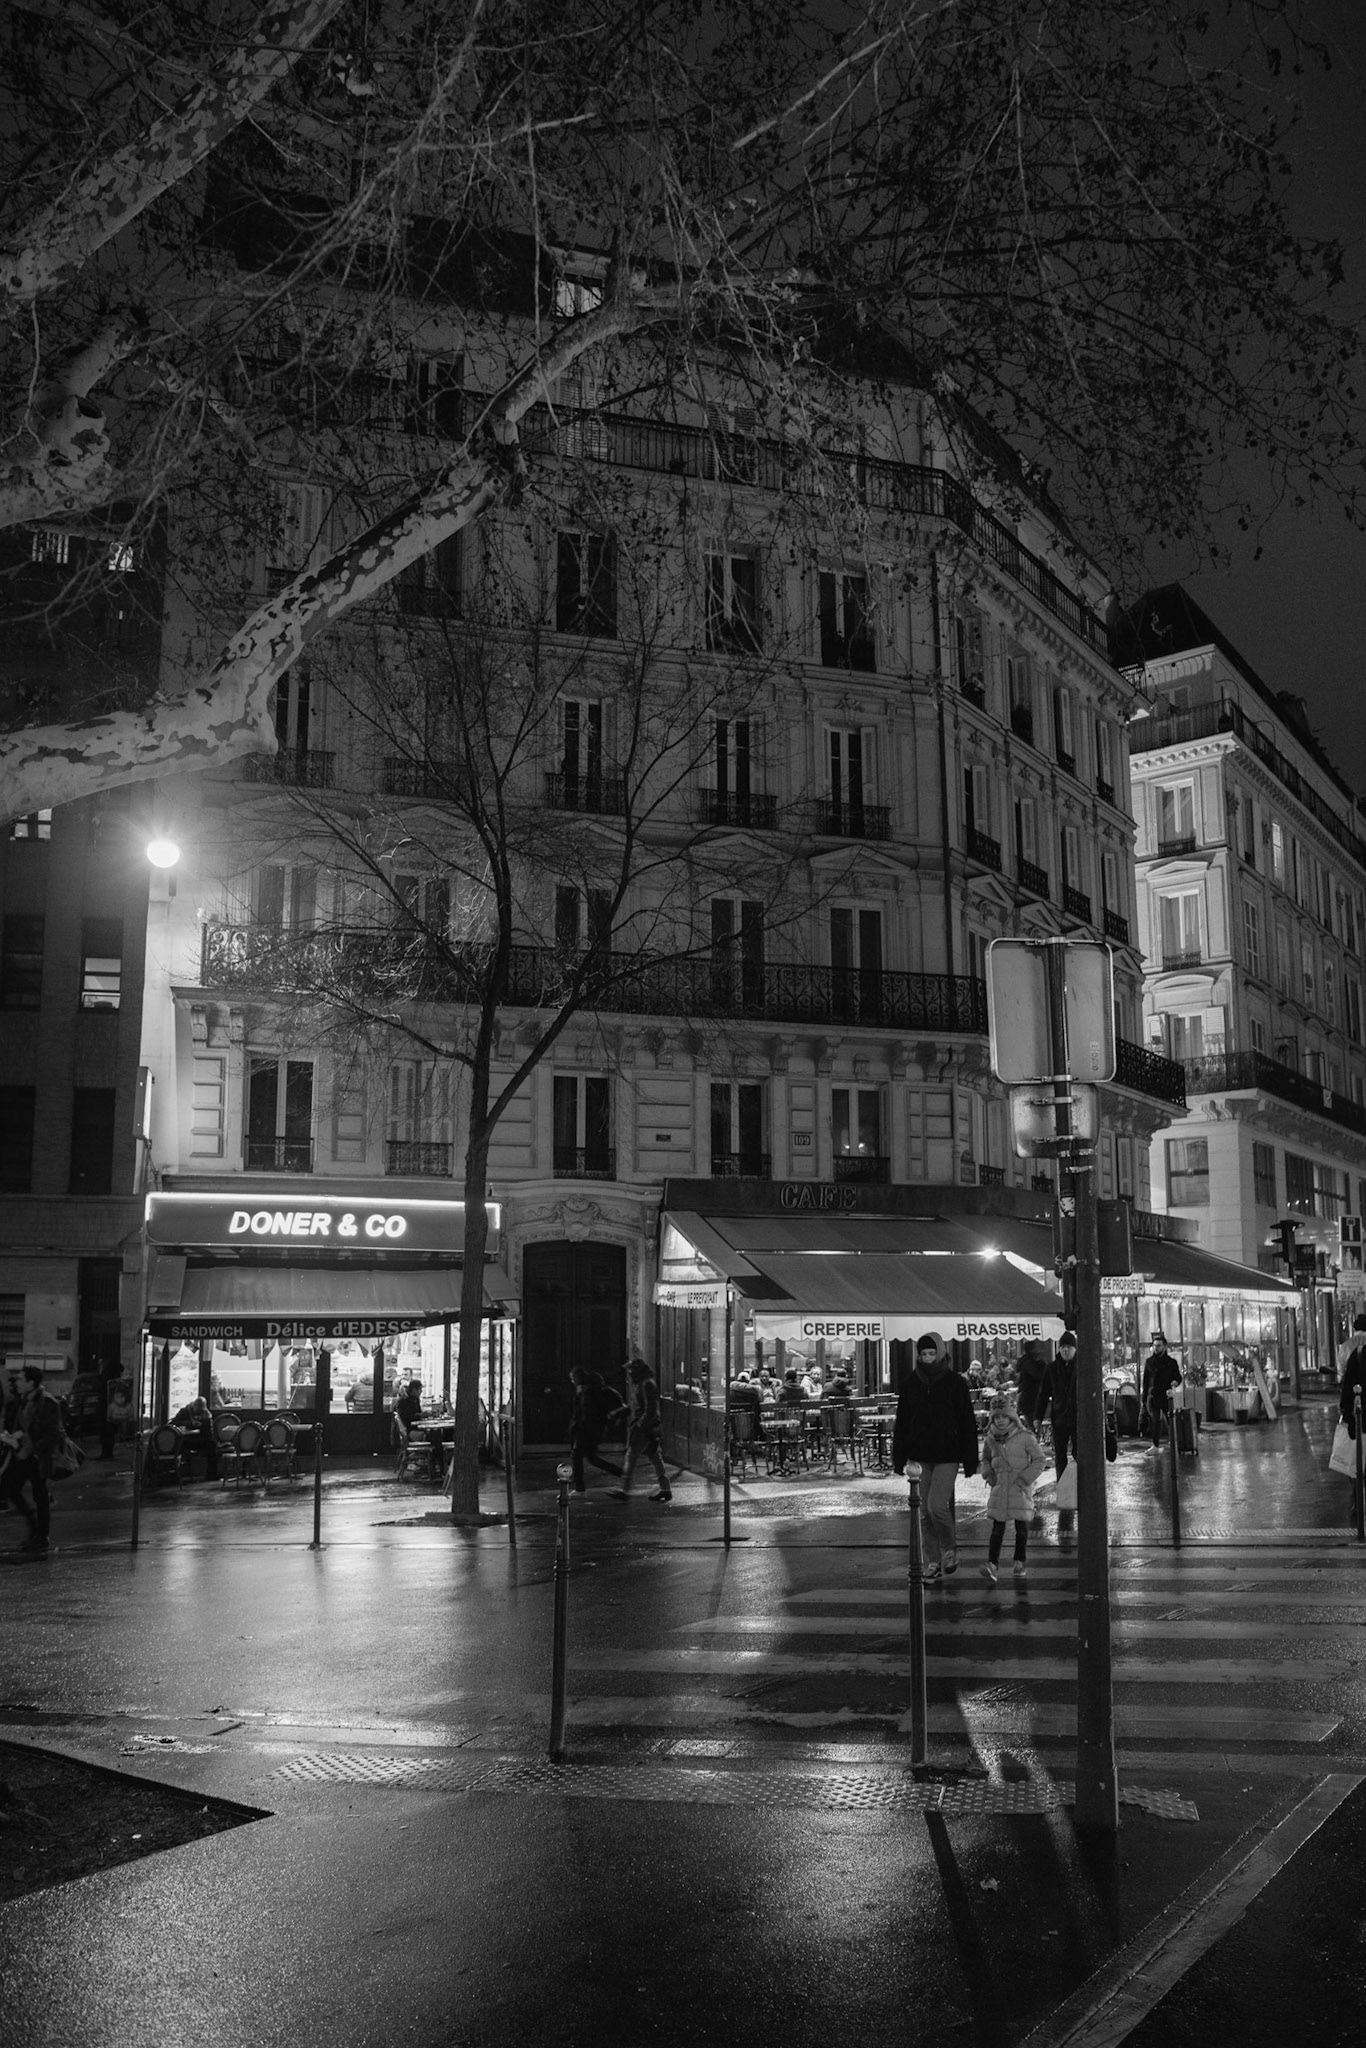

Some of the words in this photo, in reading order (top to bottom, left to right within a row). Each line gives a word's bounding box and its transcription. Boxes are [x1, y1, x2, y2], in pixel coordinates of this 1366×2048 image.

[795, 1135, 810, 1146] 109
[780, 1183, 857, 1209] CAFE
[229, 1210, 332, 1236] DONER
[337, 1213, 358, 1237] &
[364, 1214, 407, 1238] CO
[171, 1326, 243, 1337] SANDWICH
[266, 1322, 327, 1337] Délice
[803, 1322, 881, 1336] CREPERIE
[957, 1323, 1041, 1336] BRASSERIE
